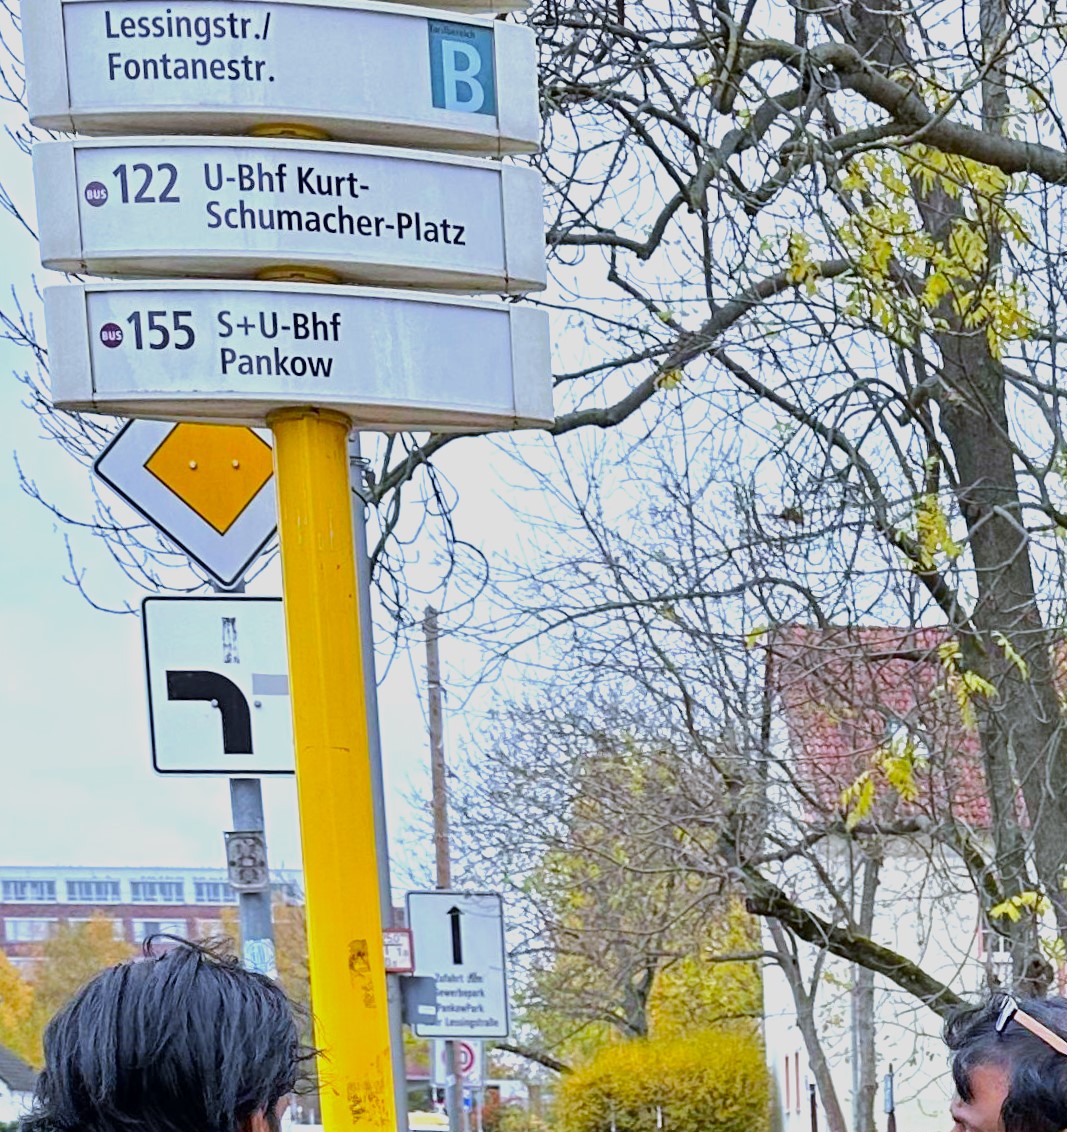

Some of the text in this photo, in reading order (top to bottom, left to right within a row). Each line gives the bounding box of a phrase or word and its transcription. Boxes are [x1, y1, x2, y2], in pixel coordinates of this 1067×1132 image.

[104, 8, 271, 46] Lessingstr./
[108, 52, 275, 82] Fontanestr.
[441, 39, 484, 113] B
[86, 162, 180, 204] BUS 122
[204, 162, 369, 198] U-Bhf Kurt-
[206, 200, 466, 246] Schumacher-Platz
[101, 310, 196, 350] BUS 155
[217, 310, 341, 342] S+U-Bhf
[220, 347, 333, 377] Pankow
